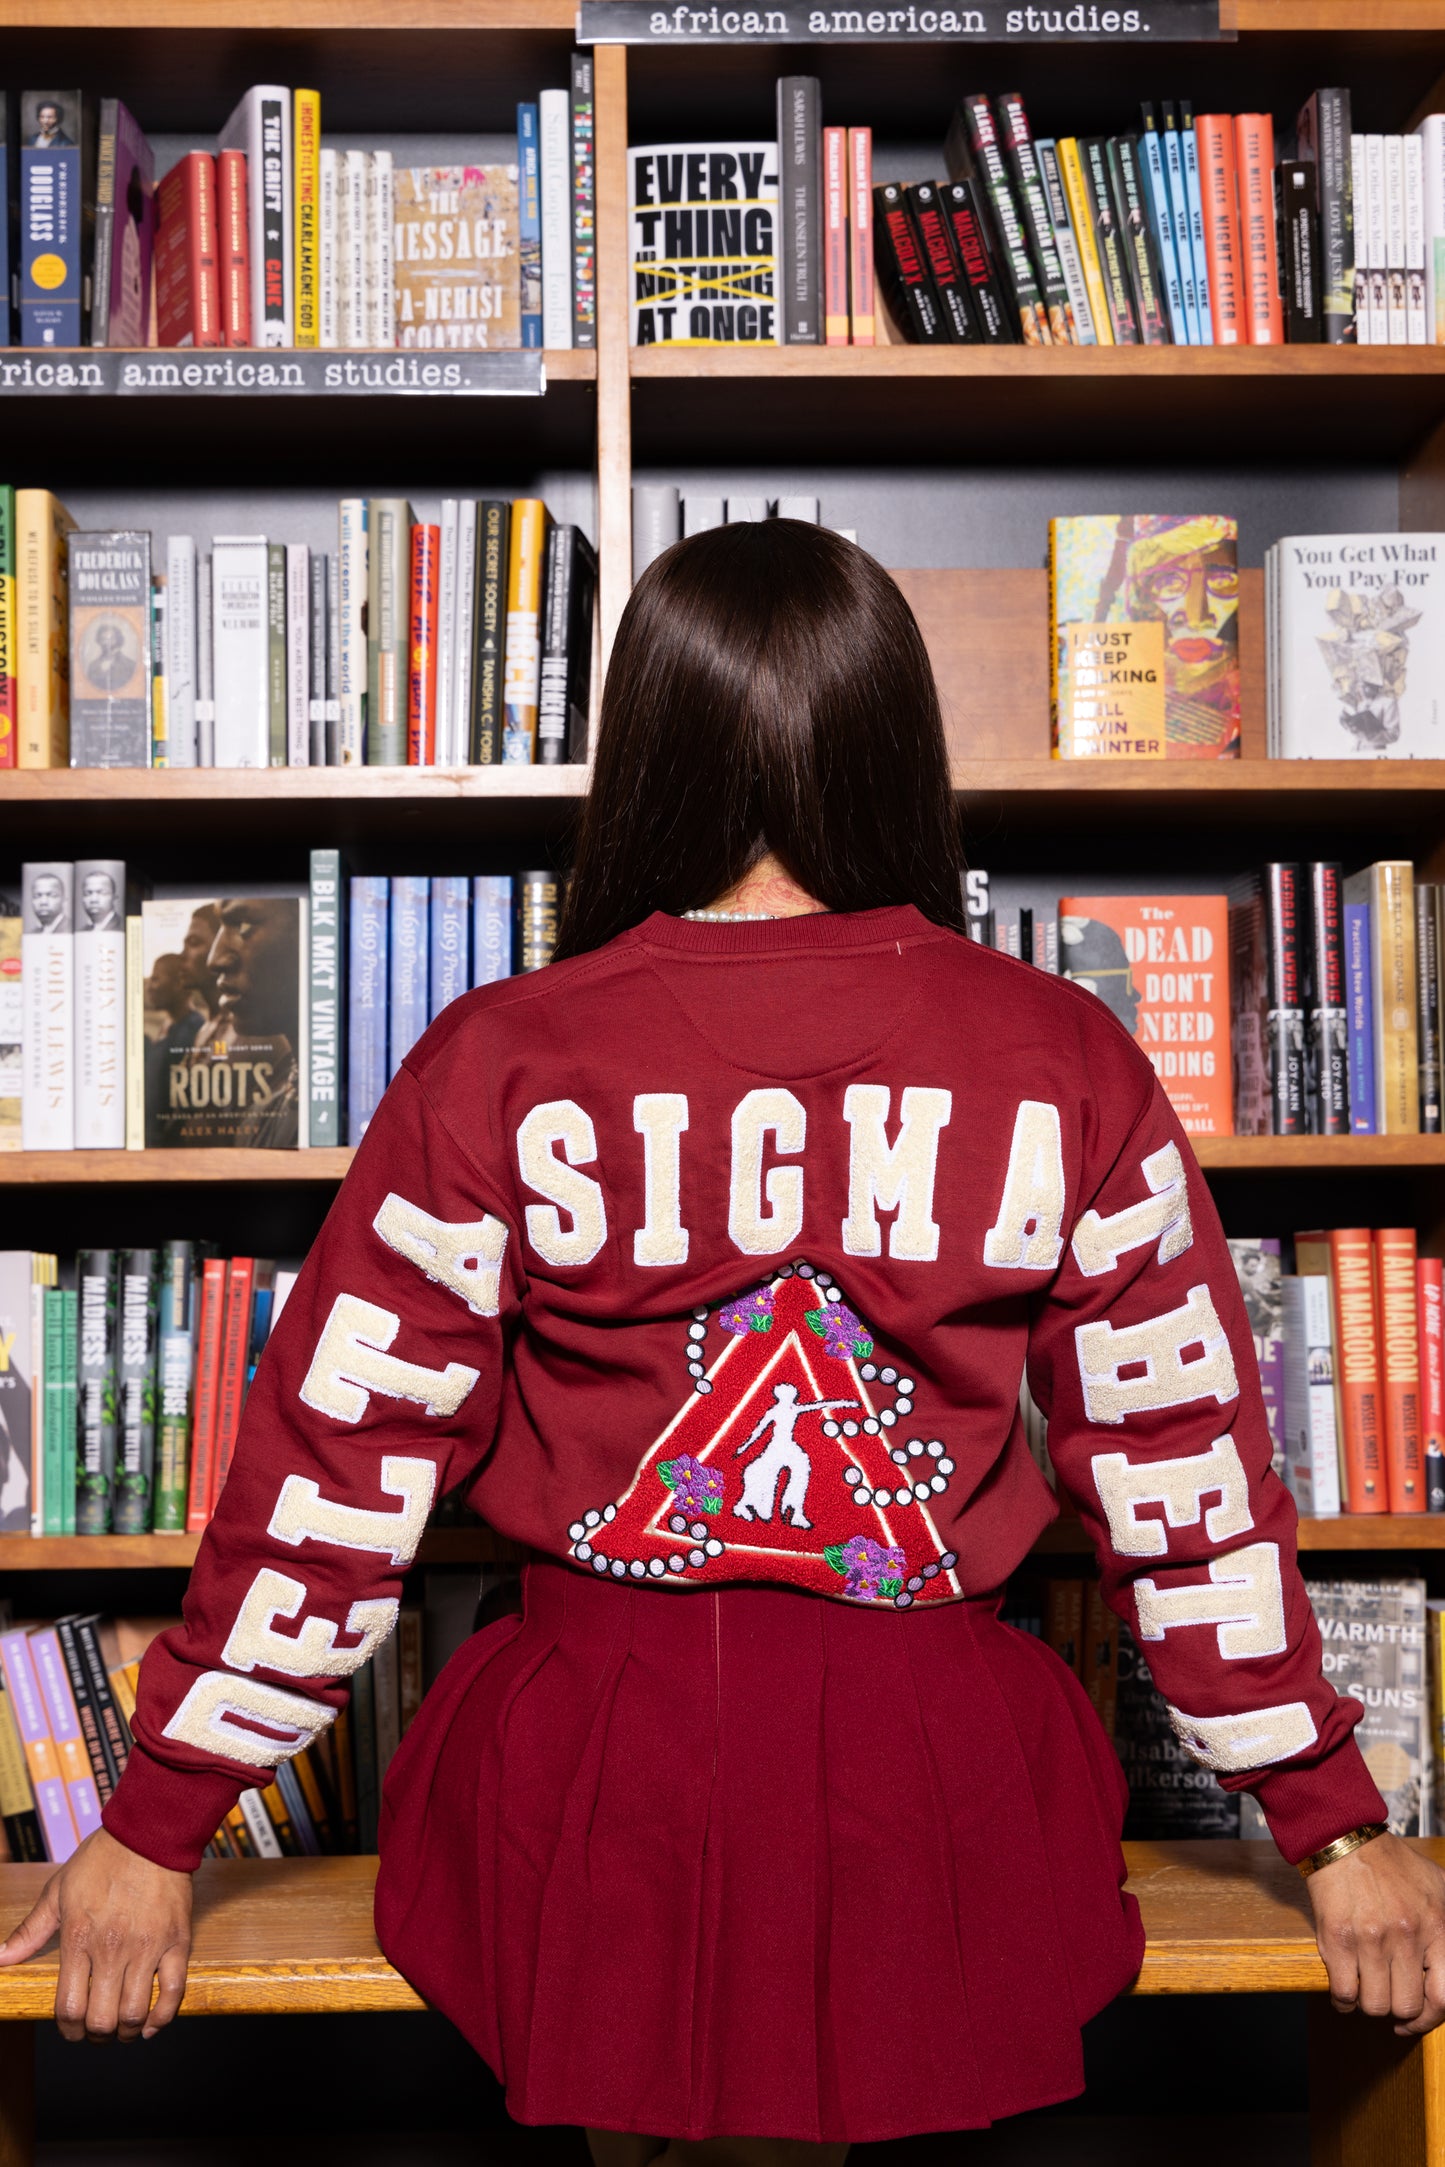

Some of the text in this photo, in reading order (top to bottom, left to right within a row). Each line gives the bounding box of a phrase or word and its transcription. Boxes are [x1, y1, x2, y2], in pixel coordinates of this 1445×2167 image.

[650, 5, 1151, 34] african american studies.
[793, 90, 806, 166] SARAH LEWIS
[526, 147, 536, 175] AFRICA
[635, 152, 778, 207] EVERY-
[856, 133, 867, 182] MALCOLM
[1119, 143, 1138, 207] THE SUM OF US
[1151, 144, 1160, 174] VIBE
[30, 165, 54, 242] DOUGLASS
[264, 116, 282, 307] THE GRIFT CANE
[429, 191, 460, 215] THE
[527, 176, 536, 198] SINCE
[857, 192, 867, 228] SPEAKS
[973, 103, 1032, 281] BLACK LIVES, AMERICAN LOVE
[1007, 102, 1062, 280] BLACK LIVES, AMERICAN LOVE
[1042, 150, 1064, 223] JAMES McBRIDE
[1250, 168, 1262, 204] MILES
[301, 106, 314, 328] HONEST LYING CHARLAMAGNE GOD
[545, 113, 568, 340] Sarah Cooper Foolish
[575, 102, 594, 325] THE BLACK JOY PROJECT
[635, 208, 773, 259] THING
[1161, 212, 1170, 242] VIBE
[795, 186, 808, 302] THE UNSEEN TRUTH
[885, 210, 923, 285] MALCOLM X
[918, 210, 955, 286] MALCOLM X
[952, 210, 988, 286] MALCOLM X
[1250, 215, 1269, 320] NIGHT FLYER
[1328, 200, 1346, 305] LOVE & JUSTICE
[635, 265, 774, 303] NOTHING
[1062, 239, 1091, 328] THE COLOR OF WATER
[1133, 236, 1155, 314] HEATHER MCGHEE
[1170, 280, 1181, 310] VIBE
[637, 304, 774, 346] AT ONCE
[0, 359, 472, 388] rican american studies.
[342, 515, 352, 540] will
[554, 530, 566, 564] HENRY
[75, 551, 143, 570] FREDERICK
[342, 544, 350, 601] scream
[484, 508, 500, 633] OUR SECRET SOCIETY
[553, 565, 564, 596] LOUIS
[1294, 544, 1437, 565] You Get What
[1303, 570, 1430, 591] You Pay For
[78, 572, 141, 591] DOUGLASS
[342, 605, 352, 619] to
[342, 623, 352, 646] the
[503, 611, 538, 706] HBCU
[550, 632, 561, 650] JR.
[342, 651, 352, 694] world
[538, 657, 568, 739] THE BLACK BOX
[480, 660, 495, 765] TANISHA C. FORD
[1140, 907, 1174, 921] The
[1322, 868, 1338, 927] MEDGAR
[397, 909, 418, 947] 1619
[1124, 926, 1214, 963] DEAD
[1392, 876, 1405, 1002] THE BLACK UTOPIANS
[359, 912, 380, 1009] 1619 Project
[1325, 950, 1340, 1003] MYRLIE
[1351, 919, 1365, 1030] Practicing New Worlds
[312, 879, 335, 1101] BLK MKT VINTAGE
[1145, 973, 1214, 1003] DON'T
[49, 945, 64, 1110] JOHN LEWIS
[1142, 1012, 1215, 1042] NEED
[169, 1062, 273, 1109] ROOTS
[1320, 1069, 1331, 1100] REID
[1331, 1055, 1343, 1110] JOY-ANN
[516, 1084, 1066, 1270] SIGMA
[81, 1275, 107, 1366] MADNESS
[1382, 1241, 1419, 1383] I AM MAROON
[163, 1336, 187, 1359] WE
[163, 1362, 187, 1416] REFUSE
[1402, 1393, 1417, 1433] RUSSELL
[161, 1192, 509, 1768] DELTA
[1071, 1140, 1318, 1772] THETA
[1317, 1618, 1418, 1644] WARMTH
[1321, 1653, 1351, 1673] OF
[1347, 1682, 1418, 1710] SUNS
